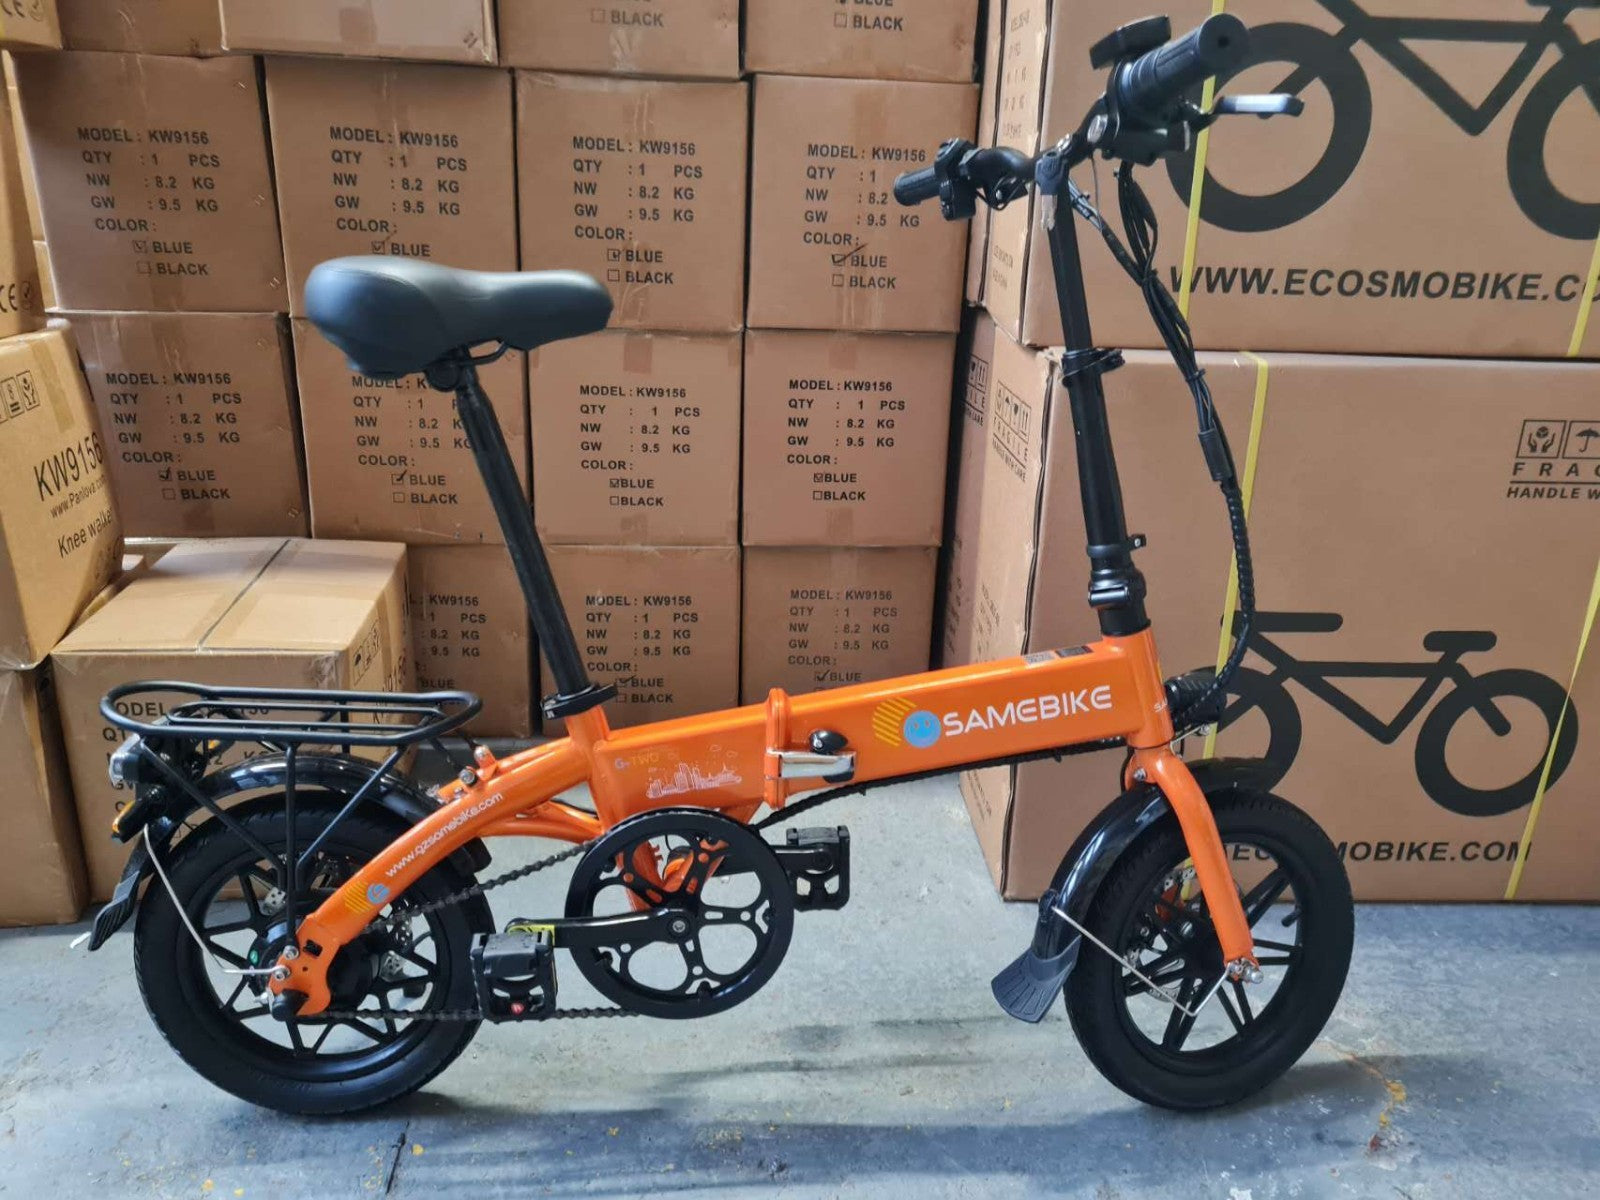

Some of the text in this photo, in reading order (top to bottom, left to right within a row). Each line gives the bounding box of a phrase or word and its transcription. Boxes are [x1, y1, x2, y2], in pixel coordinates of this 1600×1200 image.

[611, 10, 664, 27] BLACK
[853, 15, 903, 31] BLACK
[148, 130, 209, 144] KW9156
[400, 131, 458, 148] KW9156
[640, 140, 695, 155] KW9156
[82, 150, 111, 163] QTY
[189, 154, 220, 167] PCS
[332, 150, 362, 164] QTY
[437, 157, 467, 171] PCS
[872, 147, 925, 162] KW9156
[573, 159, 602, 172] QTY
[674, 165, 702, 179] PCS
[807, 166, 835, 180] QTY
[86, 174, 215, 189] NW 8.2 KG
[334, 173, 459, 193] NW 8.2 KG
[574, 181, 694, 200] NW 8.2 KG
[806, 188, 888, 205] NW 8.2
[91, 196, 218, 212] GW 9.5 KG
[335, 195, 460, 215] GW 9.5 KG
[574, 204, 693, 222] GW 9.5 KG
[805, 210, 919, 227] GW 9.5 KG
[153, 241, 193, 254] BLUE
[391, 243, 430, 257] BLUE
[626, 250, 663, 262] BLUE
[851, 255, 887, 267] BLUE
[157, 263, 208, 275] BLACK
[626, 271, 673, 284] BLACK
[850, 276, 896, 289] BLACK
[1170, 266, 1600, 302] WWW.ECOSMOBIKE.C
[174, 373, 231, 384] KW9156
[844, 381, 892, 391] KW9156
[637, 387, 686, 398] KW9156
[111, 393, 138, 405] QTY
[213, 393, 241, 404] PCS
[354, 396, 381, 407] QTY
[789, 399, 813, 409] QTY
[880, 400, 905, 410] PCS
[580, 404, 605, 414] QTY
[675, 407, 700, 417] PCS
[114, 413, 236, 424] NW 8.2 KG
[355, 416, 438, 429] NW 8.2
[788, 417, 894, 428] NW 8.2 KG
[581, 423, 690, 435] NW 8.2 KG
[119, 432, 240, 443] GW 9.5 KG
[357, 436, 439, 448] GW 9.5
[788, 436, 894, 447] GW 9.5 KG
[581, 441, 690, 453] GW 9.5 KG
[34, 432, 103, 501] KW9156
[177, 470, 215, 481] BLUE
[410, 475, 446, 486] BLUE
[825, 473, 856, 482] BLUE
[620, 478, 654, 488] BLUE
[181, 489, 230, 500] BLACK
[411, 493, 457, 504] BLACK
[824, 491, 865, 500] BLACK
[1507, 488, 1580, 498] HANDLE
[621, 497, 663, 506] BLACK
[58, 527, 88, 558] Knee
[430, 595, 478, 606] KW9156
[644, 596, 691, 606] KW9156
[846, 590, 892, 600] KW9156
[586, 612, 611, 622] QTY
[673, 613, 698, 623] PCS
[790, 606, 813, 616] QTY
[874, 607, 897, 617] PCS
[461, 613, 486, 624] PCS
[587, 629, 690, 639] NW 8.2 KG
[789, 623, 889, 633] NW 8.2 KG
[431, 629, 479, 640] 8.2 KG
[789, 639, 888, 650] GW 9.5 KG
[431, 646, 480, 657] 9.5 KG
[587, 646, 690, 656] GW 9.5 KG
[632, 675, 664, 687] BLUE
[830, 672, 862, 682] BLUE
[632, 694, 673, 703] BLACK
[944, 685, 1112, 736] SAMEBIKE
